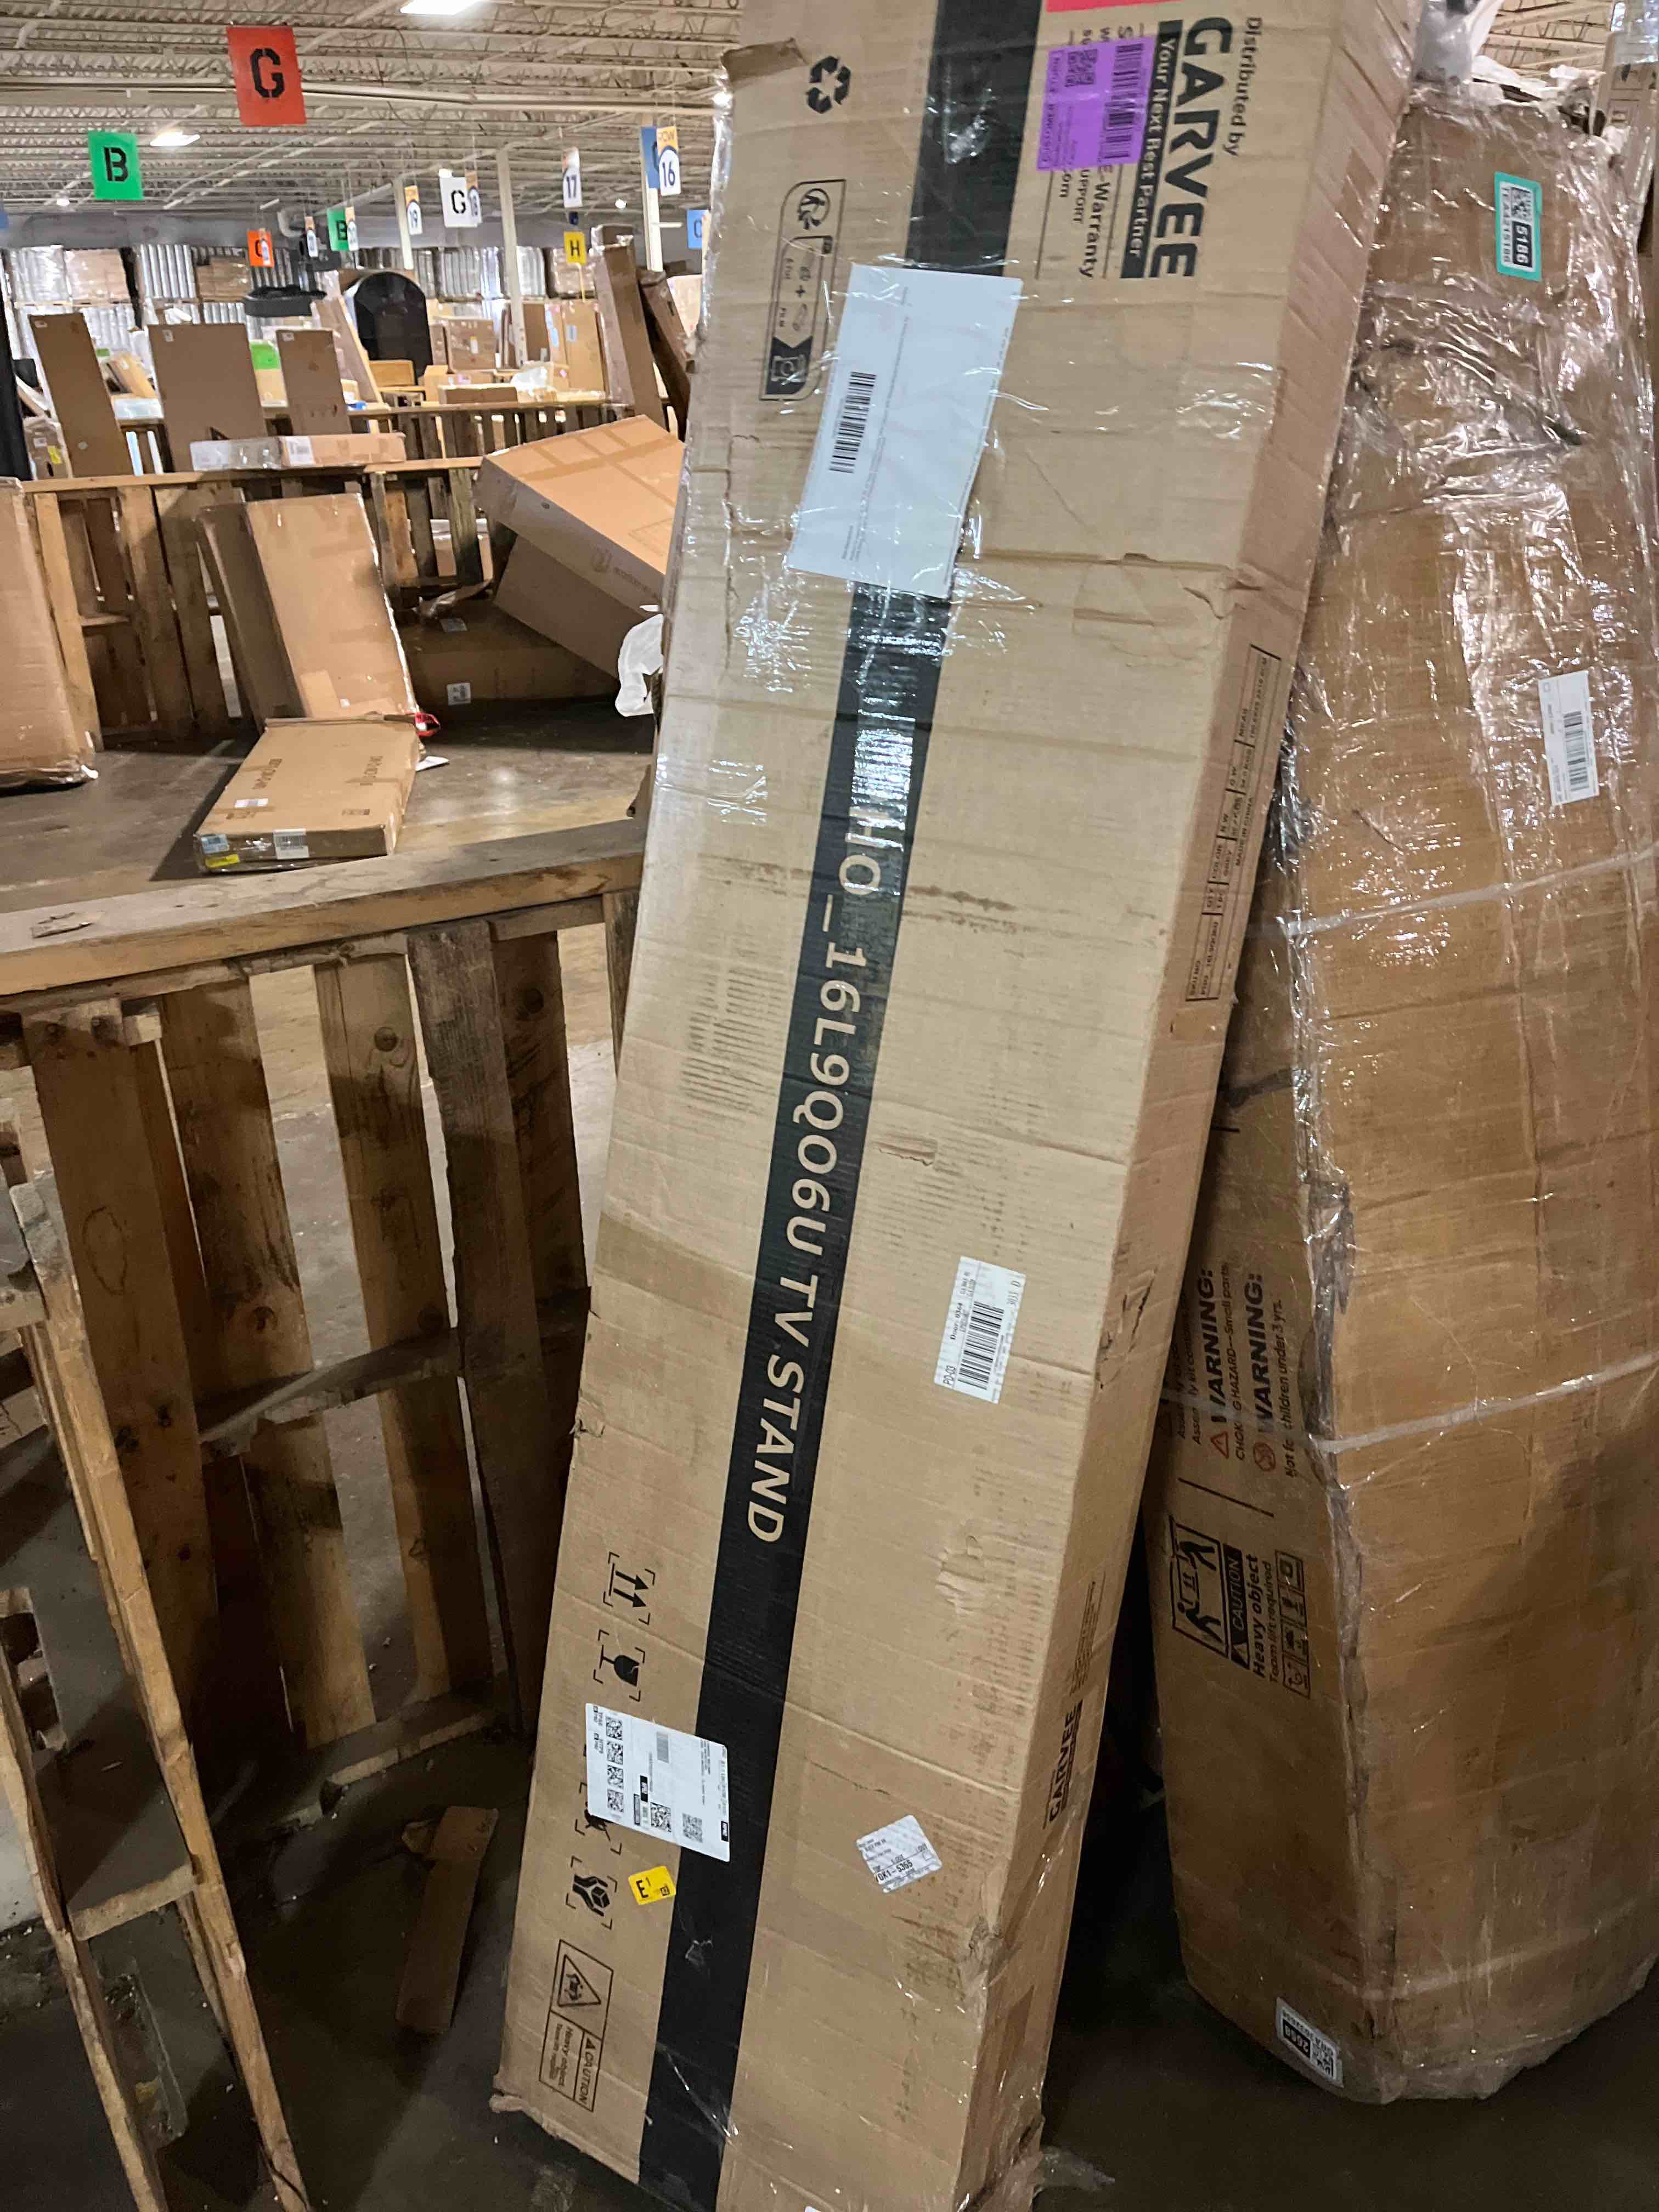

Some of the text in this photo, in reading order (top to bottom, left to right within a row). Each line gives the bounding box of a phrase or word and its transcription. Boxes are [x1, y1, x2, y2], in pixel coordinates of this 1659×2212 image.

[250, 48, 285, 98] G
[1223, 17, 1262, 157] Distributed by
[103, 146, 129, 182] B
[662, 161, 675, 187] 16
[1129, 38, 1175, 258] Your Next Best Partner
[1149, 17, 1233, 278] GARVEE
[451, 190, 466, 213] G
[566, 174, 577, 198] 17
[1073, 169, 1090, 223] UPPORT
[569, 240, 580, 256] H
[774, 1272, 820, 1347] TV
[1274, 1334, 1288, 1374] under
[747, 1355, 805, 1542] STAND
[1233, 1400, 1245, 1461] CHOKG
[1282, 1435, 1295, 1452] fo
[1228, 1558, 1245, 1631] CAUTION
[1246, 1553, 1266, 1678] Heavy object
[1262, 1561, 1274, 1623] required
[1269, 1644, 1278, 1683] Team
[636, 1880, 649, 1898] E
[579, 2051, 594, 2105] CAUTION
